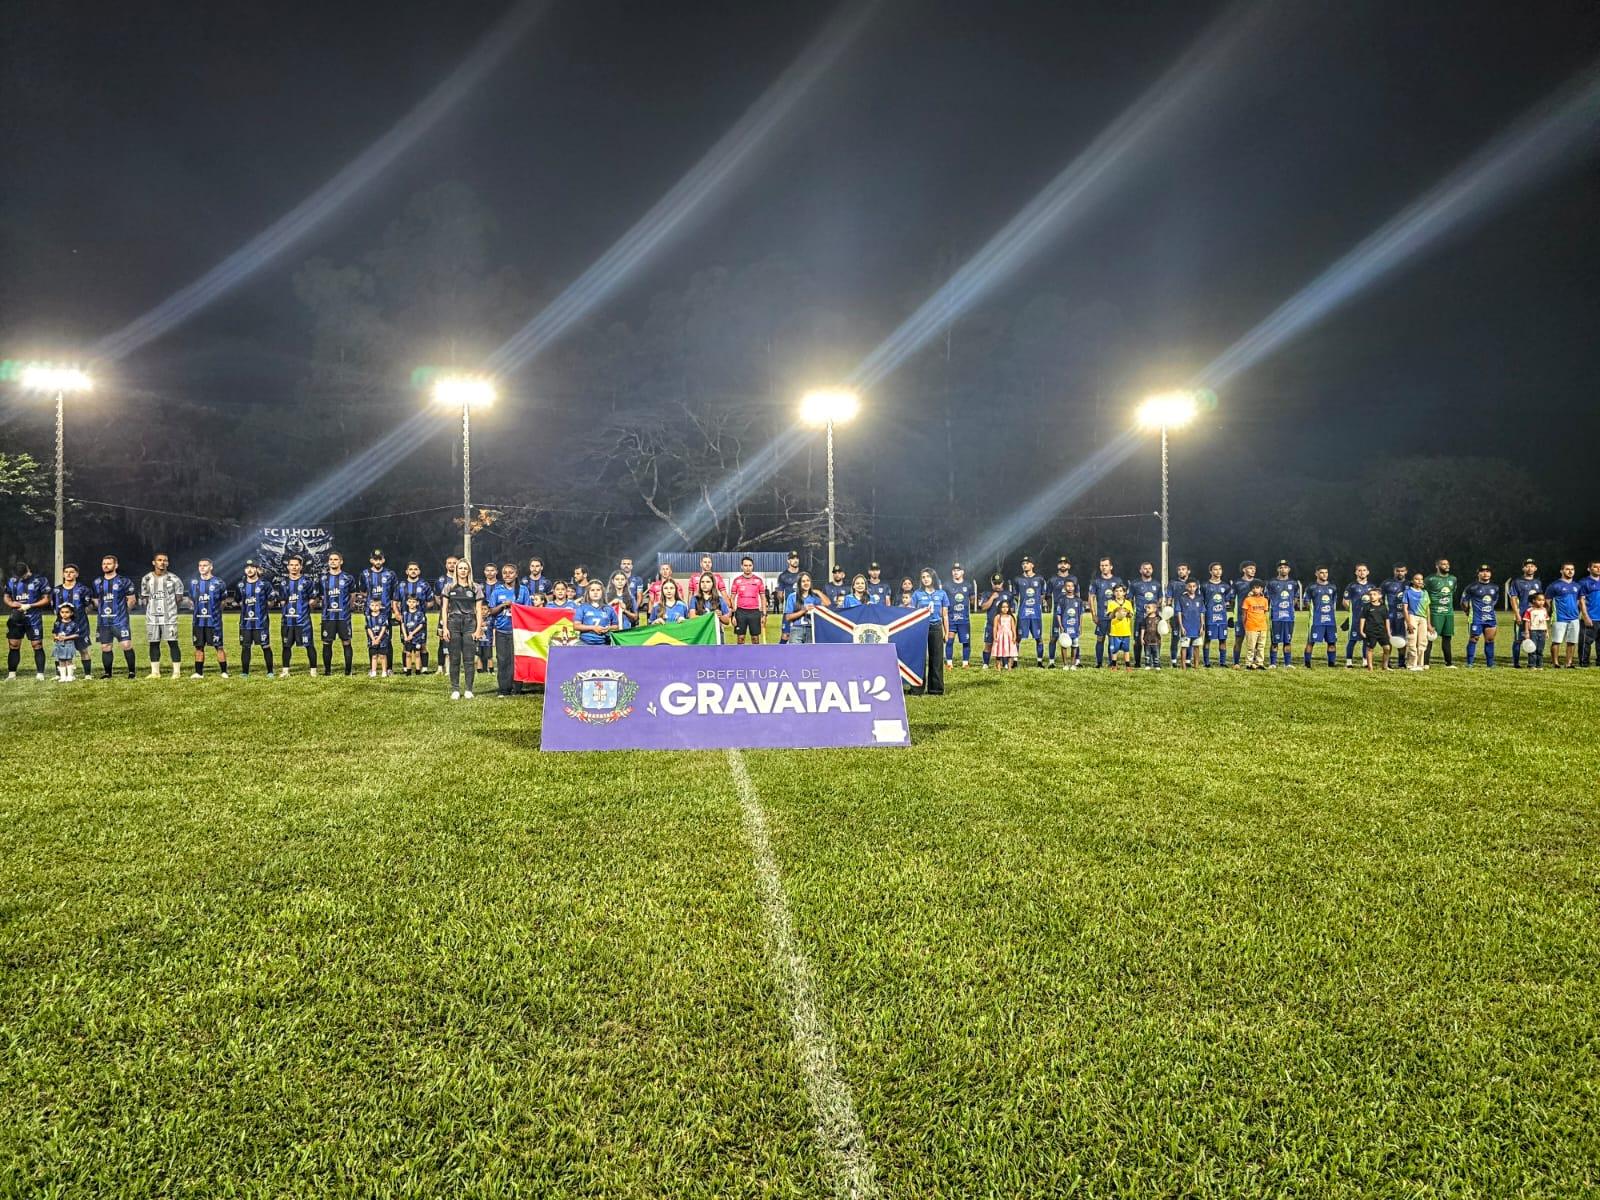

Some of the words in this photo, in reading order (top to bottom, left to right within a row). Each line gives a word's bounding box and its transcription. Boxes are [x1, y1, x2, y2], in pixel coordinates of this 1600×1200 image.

[264, 528, 279, 536] FC
[281, 528, 325, 537] ILHOTA
[697, 669, 789, 679] PREFEITURA
[801, 669, 820, 679] DE
[659, 681, 871, 715] GRAVATAL
